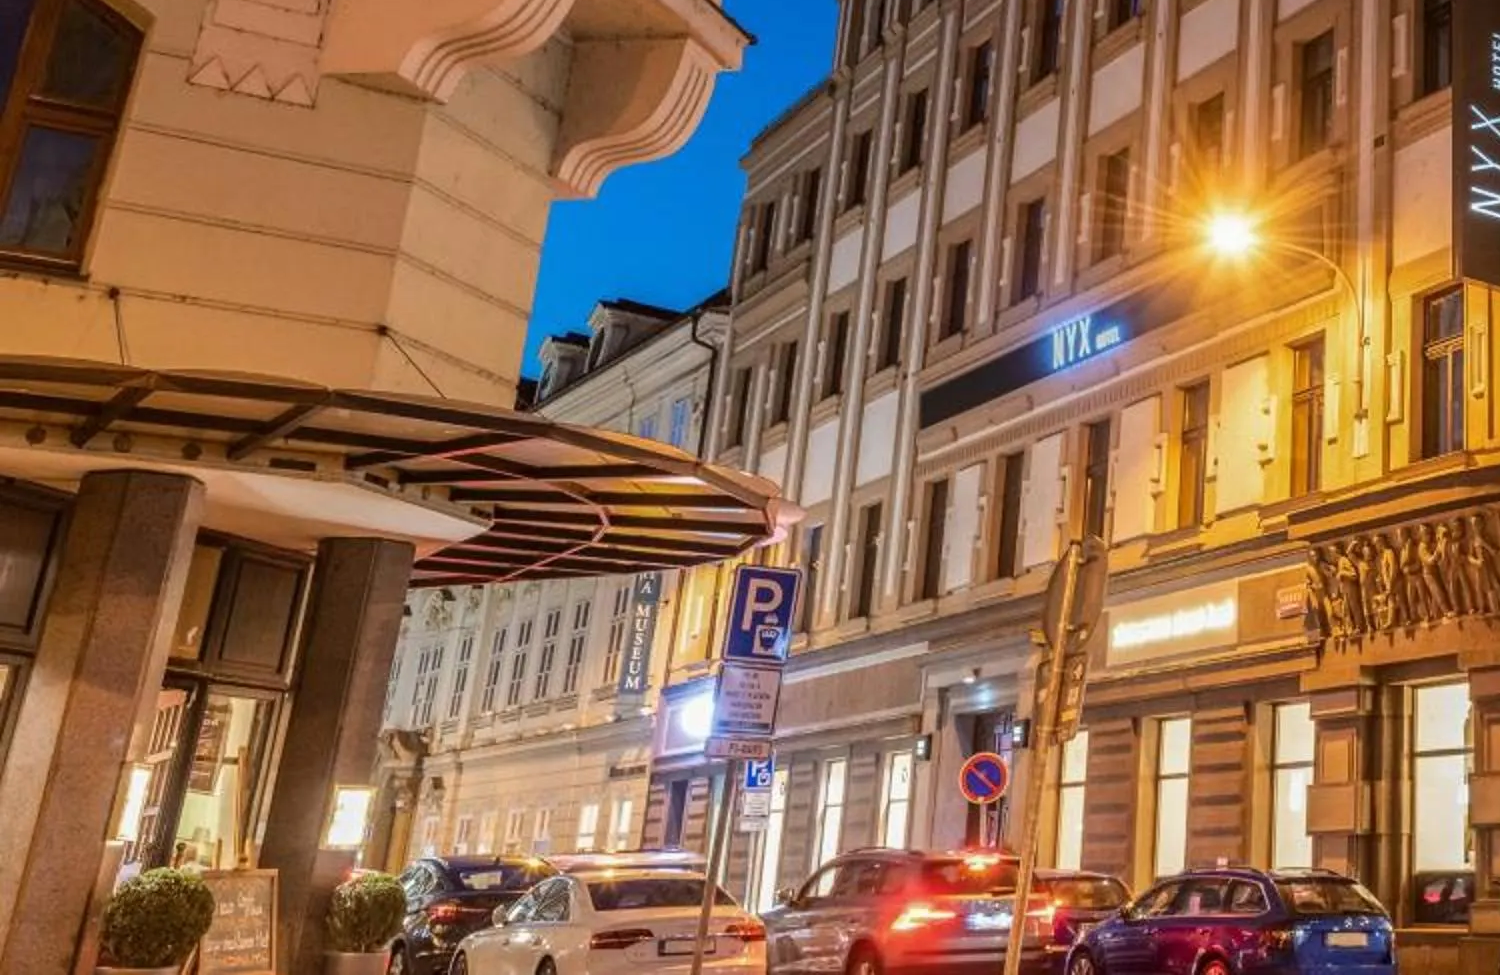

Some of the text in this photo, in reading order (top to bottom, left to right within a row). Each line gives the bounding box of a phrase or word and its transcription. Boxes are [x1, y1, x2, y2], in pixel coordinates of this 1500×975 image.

[1052, 315, 1092, 370] NYX
[741, 578, 784, 633] P
[624, 603, 651, 691] MUSEUM
